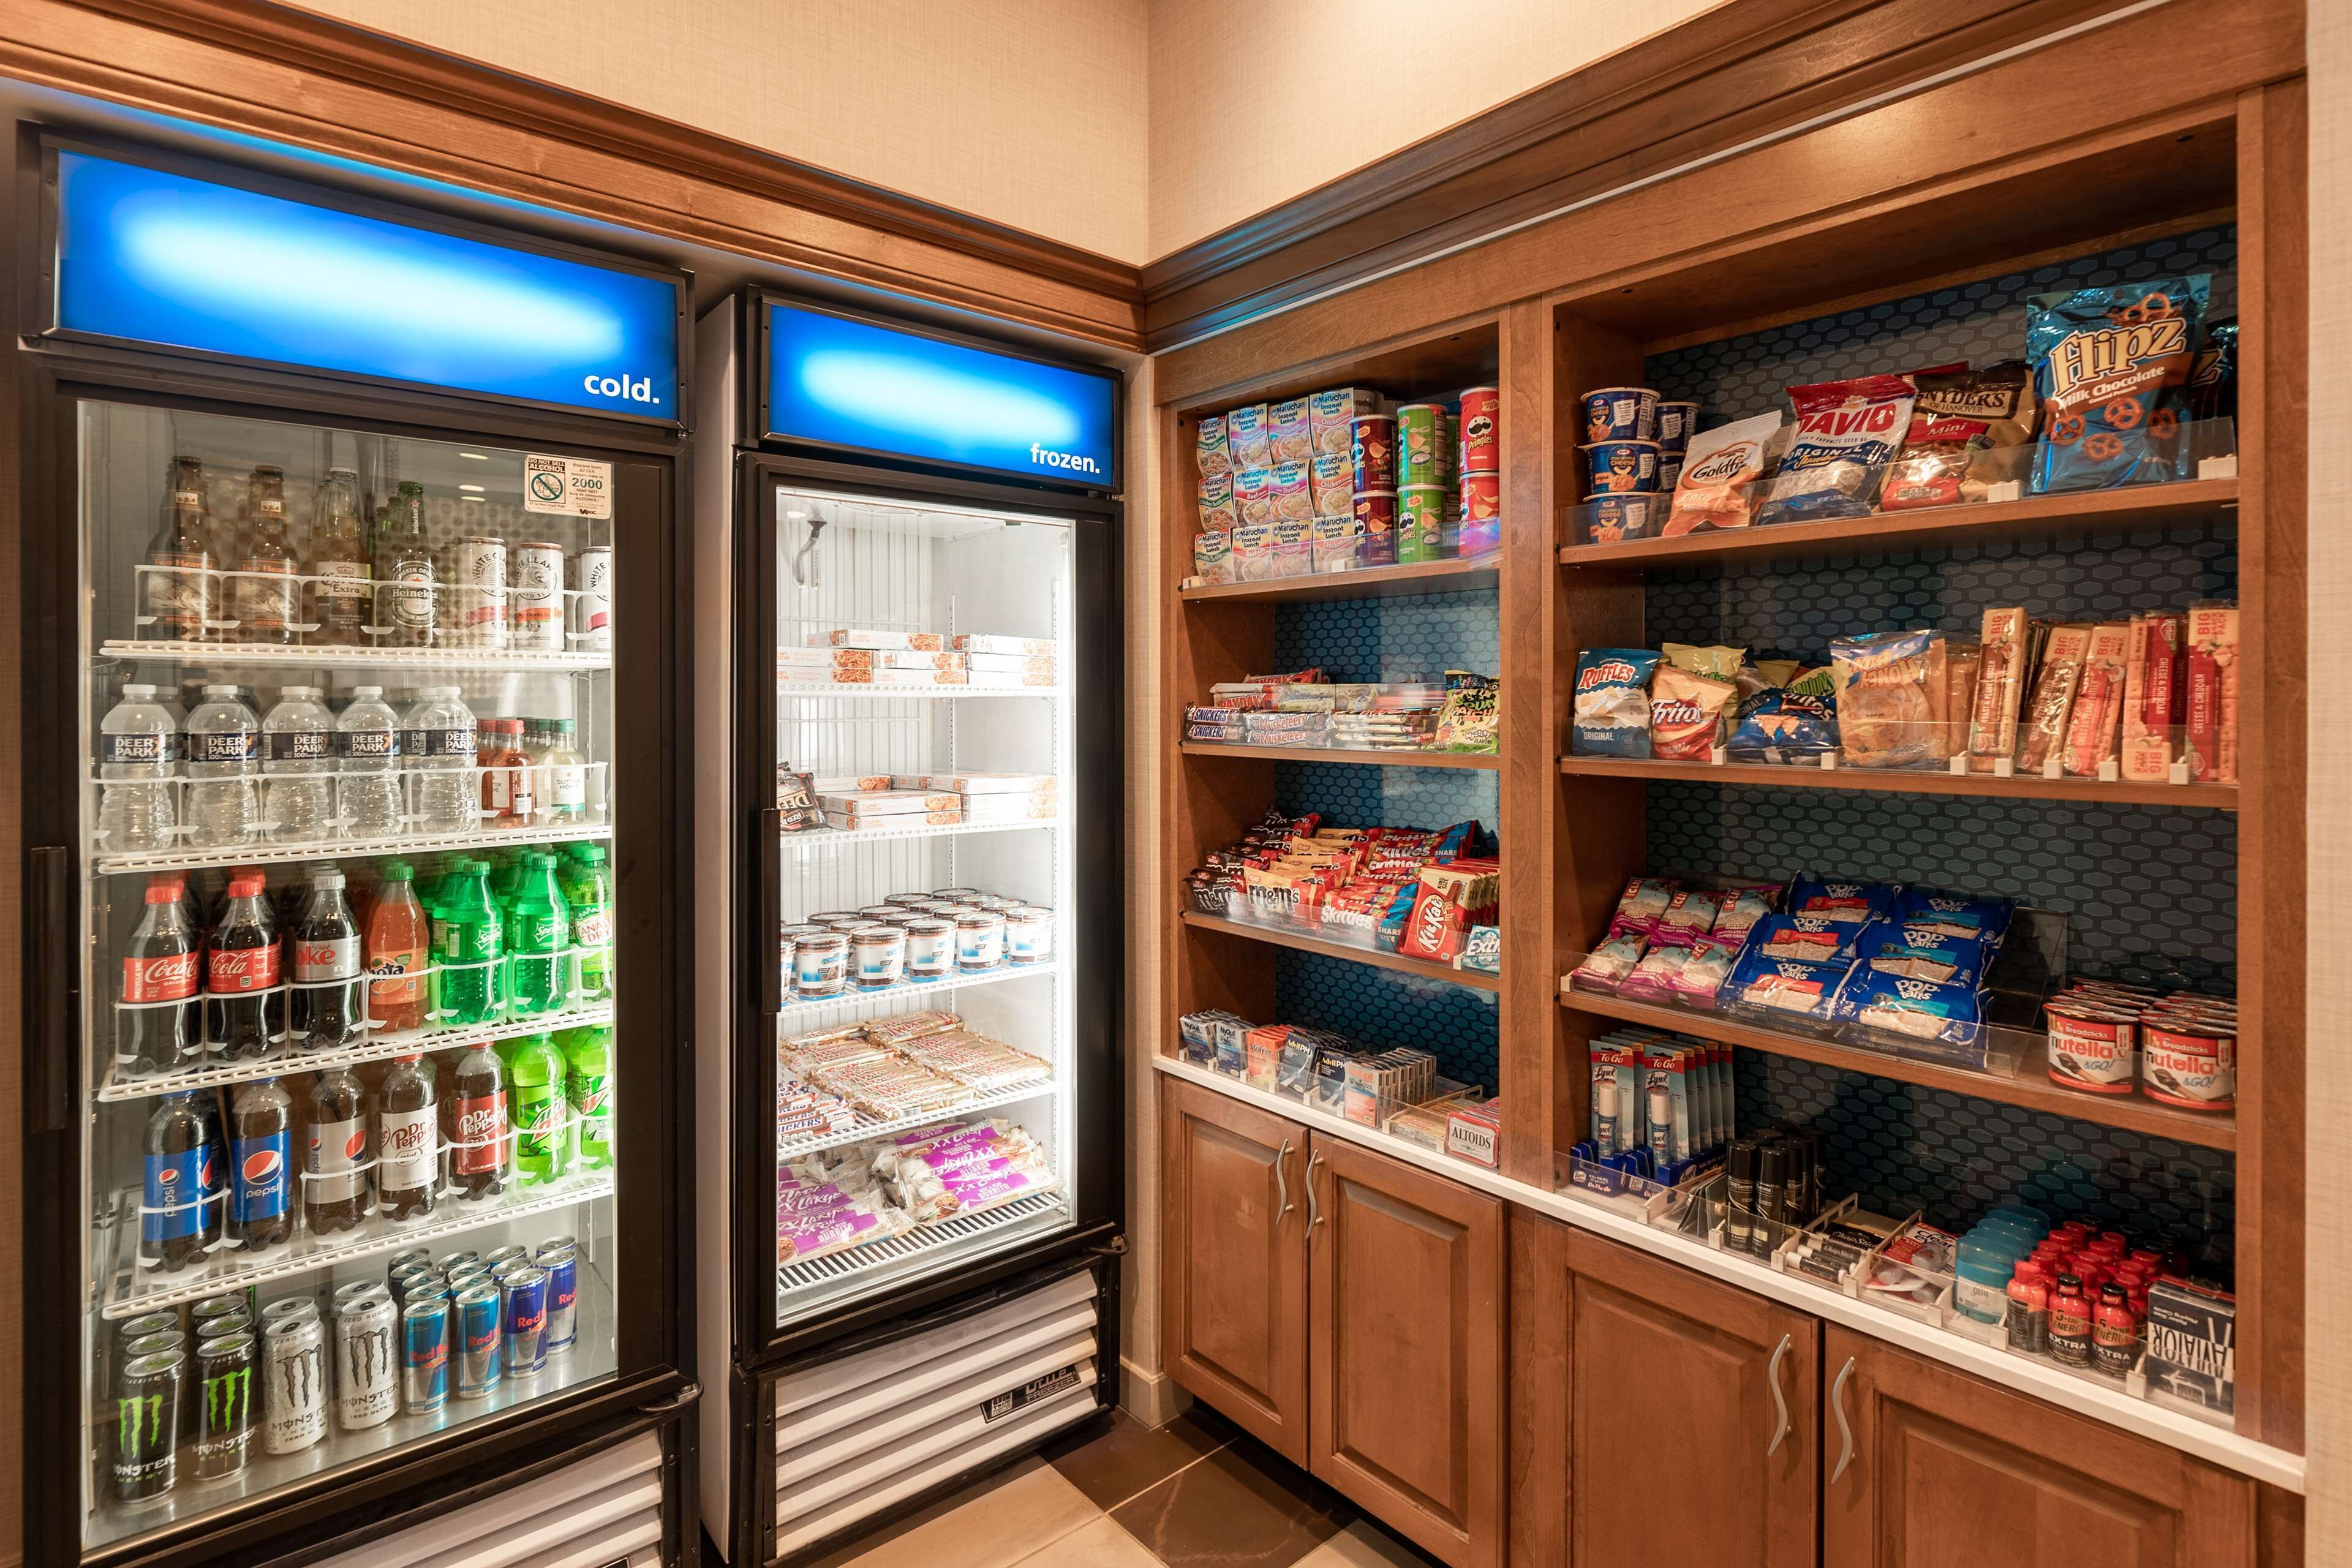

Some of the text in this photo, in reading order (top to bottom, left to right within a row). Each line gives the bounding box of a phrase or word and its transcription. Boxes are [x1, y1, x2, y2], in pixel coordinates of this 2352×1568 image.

[584, 374, 660, 404] cold.
[2059, 366, 2166, 410] Milk Chocolate
[1319, 393, 1349, 403] Maruchan
[1276, 402, 1305, 413] Maruchan
[1938, 403, 1983, 414] HANOVER
[1798, 401, 1897, 437] DAVID
[1927, 422, 1967, 438] Mini
[1468, 434, 1493, 453] Pringles
[1030, 442, 1100, 473] frozen.
[1788, 445, 1863, 462] ORIGINAL
[1318, 456, 1347, 466] Maruchan
[1693, 454, 1750, 480] Goldfi
[1794, 454, 1838, 469] Jumbo
[529, 464, 565, 472] ALCOHOL
[571, 478, 603, 489] 2000
[1321, 517, 1351, 526] Maruchan
[472, 554, 491, 579] WHITE
[590, 562, 606, 587] WHITE
[333, 584, 360, 594] Extra
[392, 589, 438, 598] Heineken
[2197, 613, 2210, 635] BIG
[1852, 649, 1892, 672] BUN
[1578, 663, 1635, 690] RUFFLES
[1858, 657, 1920, 689] HONEY
[2195, 674, 2205, 703] CHEDDAR
[1219, 695, 1261, 708] PAYDAY
[1455, 698, 1495, 711] SOUR
[1194, 710, 1228, 722] SNICKERS
[1453, 706, 1493, 716] PATCH
[1653, 699, 1703, 723] Fritos
[1259, 714, 1307, 730] Musketeers
[2194, 710, 2204, 734] CHEESE
[352, 735, 384, 744] DEER
[445, 733, 473, 742] DEER
[1194, 727, 1225, 739] SNICKERS
[1259, 731, 1310, 745] Musketeers
[1466, 730, 1491, 740] MYSTERY
[1583, 731, 1615, 742] ORIGINAL
[115, 738, 153, 747] DEER
[208, 737, 244, 746] DEER
[352, 743, 385, 752] PARK
[445, 741, 473, 750] PARK
[115, 747, 154, 757] PARK
[208, 746, 246, 756] PARK
[1248, 884, 1300, 914] m&m's
[1321, 906, 1374, 930] Skittles
[576, 919, 612, 939] CANAD
[1378, 926, 1401, 936] SHARE
[295, 946, 336, 966] oke
[135, 961, 143, 970] ME
[1220, 1026, 1235, 1037] NyQuil
[2065, 1027, 2108, 1038] Breadsticks
[1249, 1042, 1272, 1055] Motrin
[1287, 1039, 1310, 1055] Advil PM
[2052, 1035, 2113, 1060] nutella
[1322, 1056, 1346, 1069] Advil PM
[1600, 1054, 1623, 1063] To Go
[2083, 1058, 2116, 1072] &GO!
[2146, 1050, 2215, 1076] nutella
[1595, 1066, 1616, 1079] Lysol
[1647, 1072, 1667, 1085] Lysol
[473, 1109, 491, 1120] Dr
[408, 1122, 425, 1133] Dr
[780, 1117, 821, 1133] ICKERS
[1452, 1126, 1492, 1150] ALTOIDS
[246, 1183, 282, 1200] pepsi
[817, 1223, 854, 1242] BURRITO
[1917, 1230, 1953, 1250] Clear
[517, 1315, 538, 1328] Red
[468, 1335, 488, 1347] Red
[2049, 1332, 2087, 1349] EXTRA
[410, 1349, 432, 1362] Red
[2092, 1342, 2130, 1360] EXTRA
[1027, 1376, 1075, 1402] FREEZER
